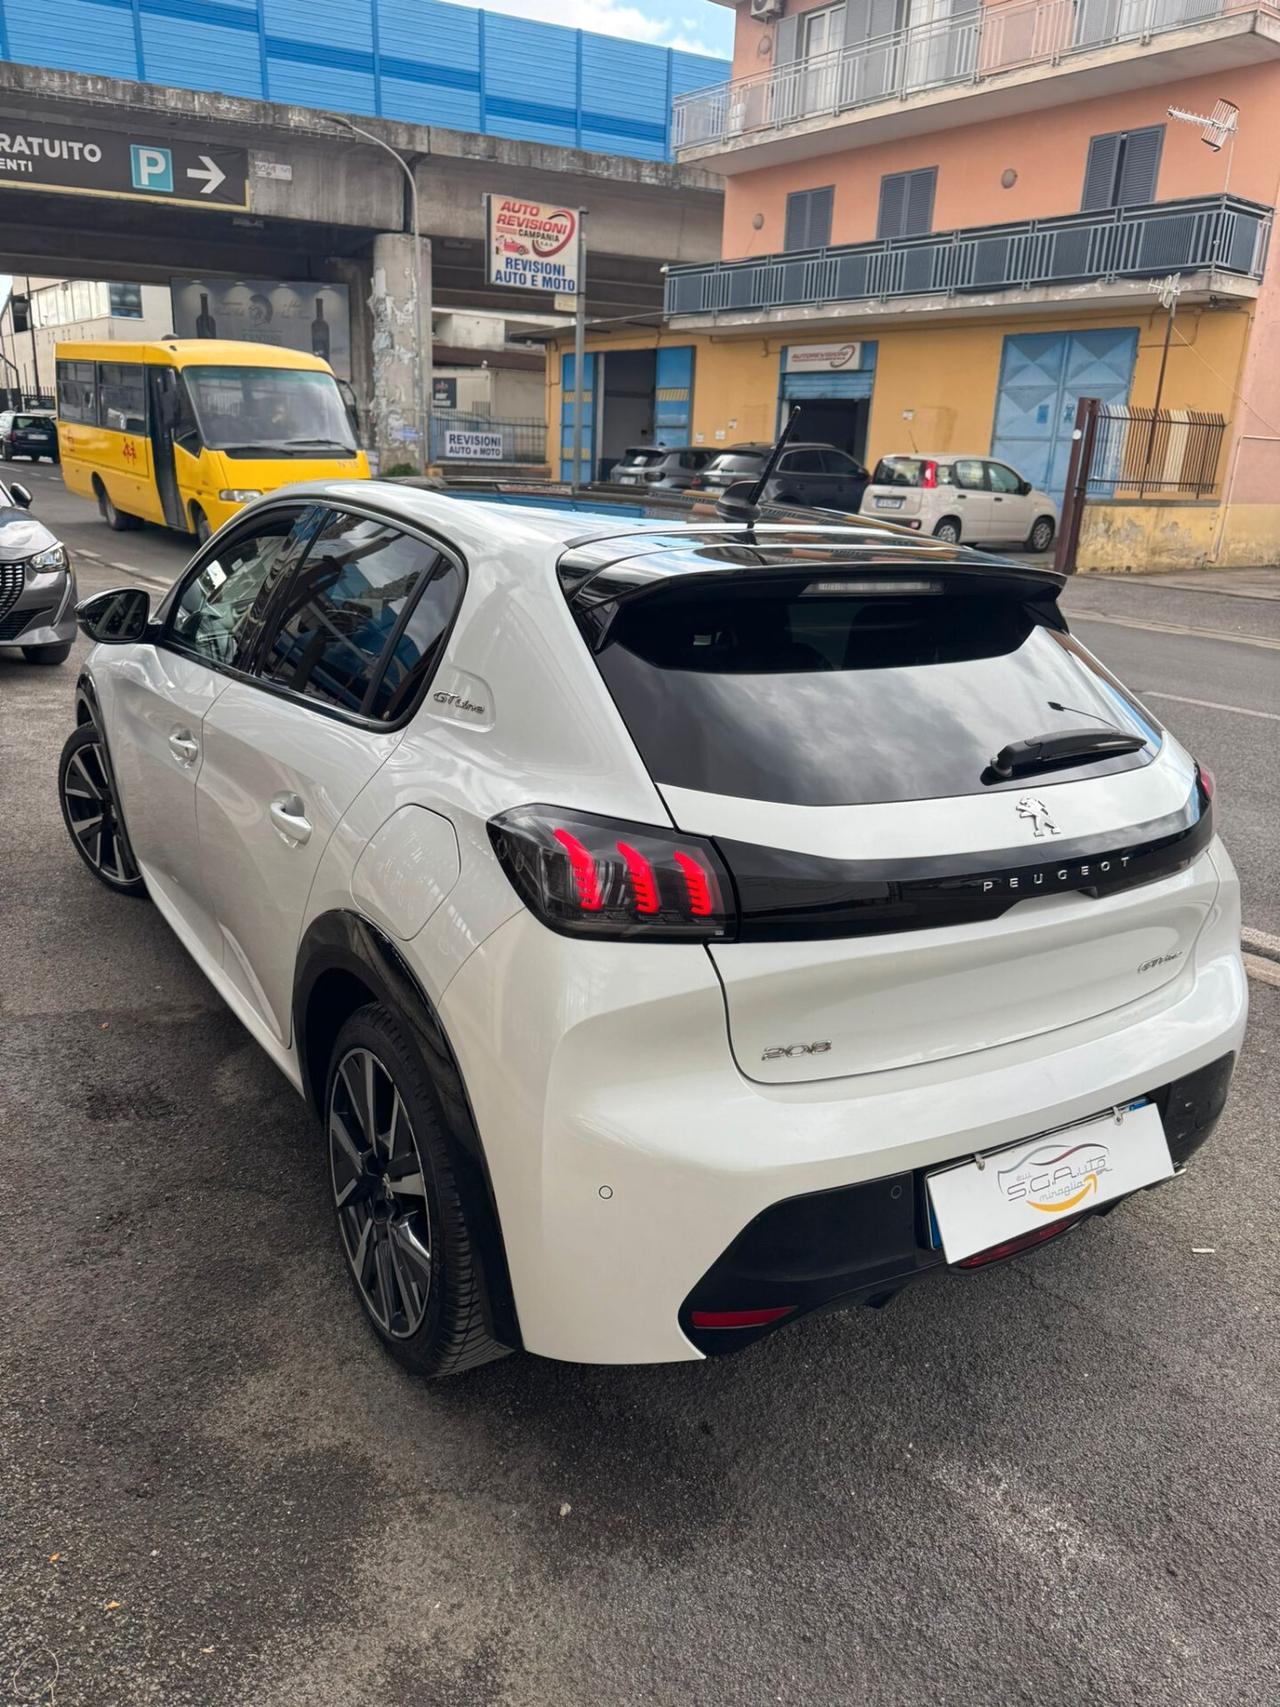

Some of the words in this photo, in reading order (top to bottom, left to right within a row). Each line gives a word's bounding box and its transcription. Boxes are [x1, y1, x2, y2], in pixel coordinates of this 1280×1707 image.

[138, 149, 166, 185] P
[500, 201, 540, 217] AUTO
[496, 213, 568, 235] REVISIONI
[518, 229, 559, 242] CAMPANIA
[505, 257, 565, 277] REVISIONI
[495, 269, 527, 285] AUTO
[531, 274, 538, 287] E
[542, 276, 575, 292] MOTO
[449, 434, 501, 446] REVISIONI
[449, 446, 472, 455] AUTO
[480, 448, 501, 456] MOTO
[983, 856, 1130, 892] PEUGEOT
[761, 1041, 832, 1061] 208
